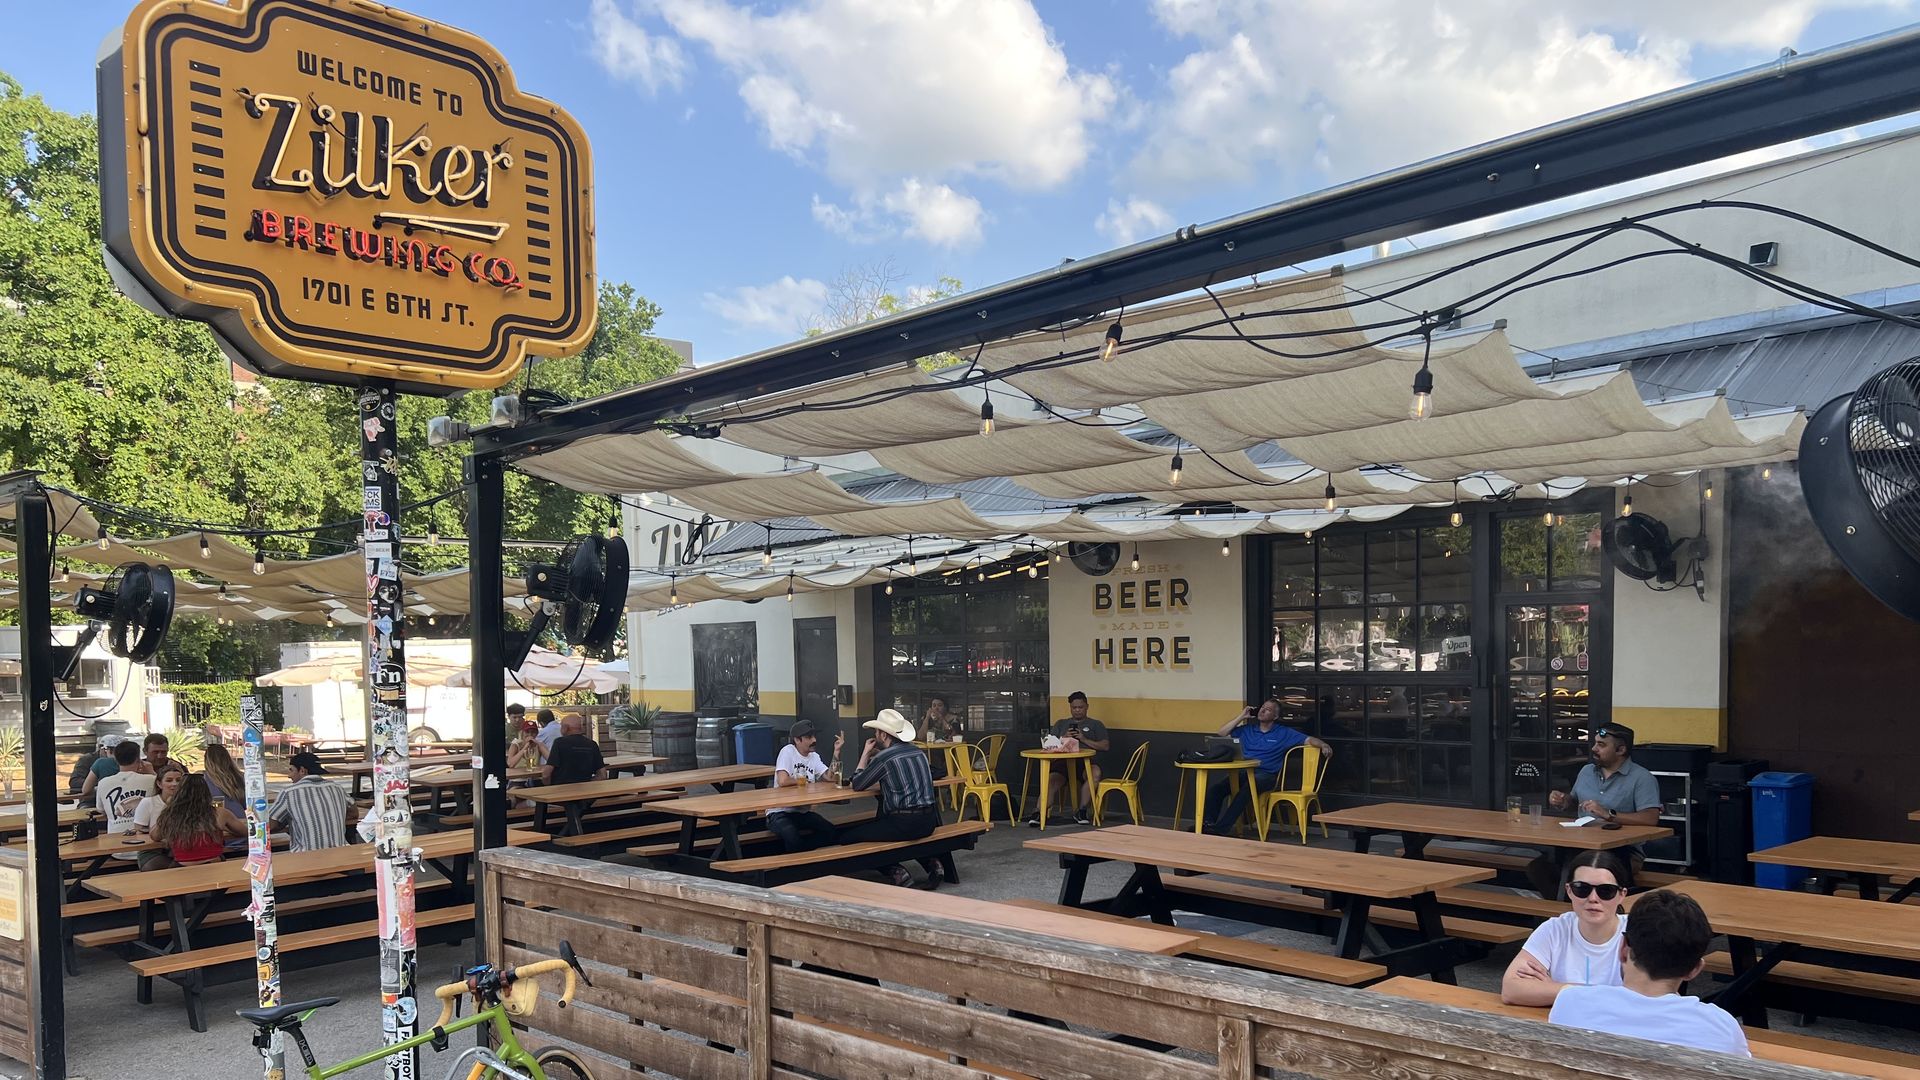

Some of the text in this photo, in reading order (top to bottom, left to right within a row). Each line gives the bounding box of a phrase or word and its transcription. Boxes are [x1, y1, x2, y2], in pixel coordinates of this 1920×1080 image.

[297, 49, 463, 116] WELCOME TO
[243, 91, 514, 209] Zilker
[252, 209, 455, 278] BREWING
[302, 277, 475, 327] 1701 E 6TH ST.
[1094, 578, 1191, 614] BEER
[1111, 621, 1171, 631] MADE
[1446, 640, 1469, 652] Open
[1094, 636, 1192, 671] HERE
